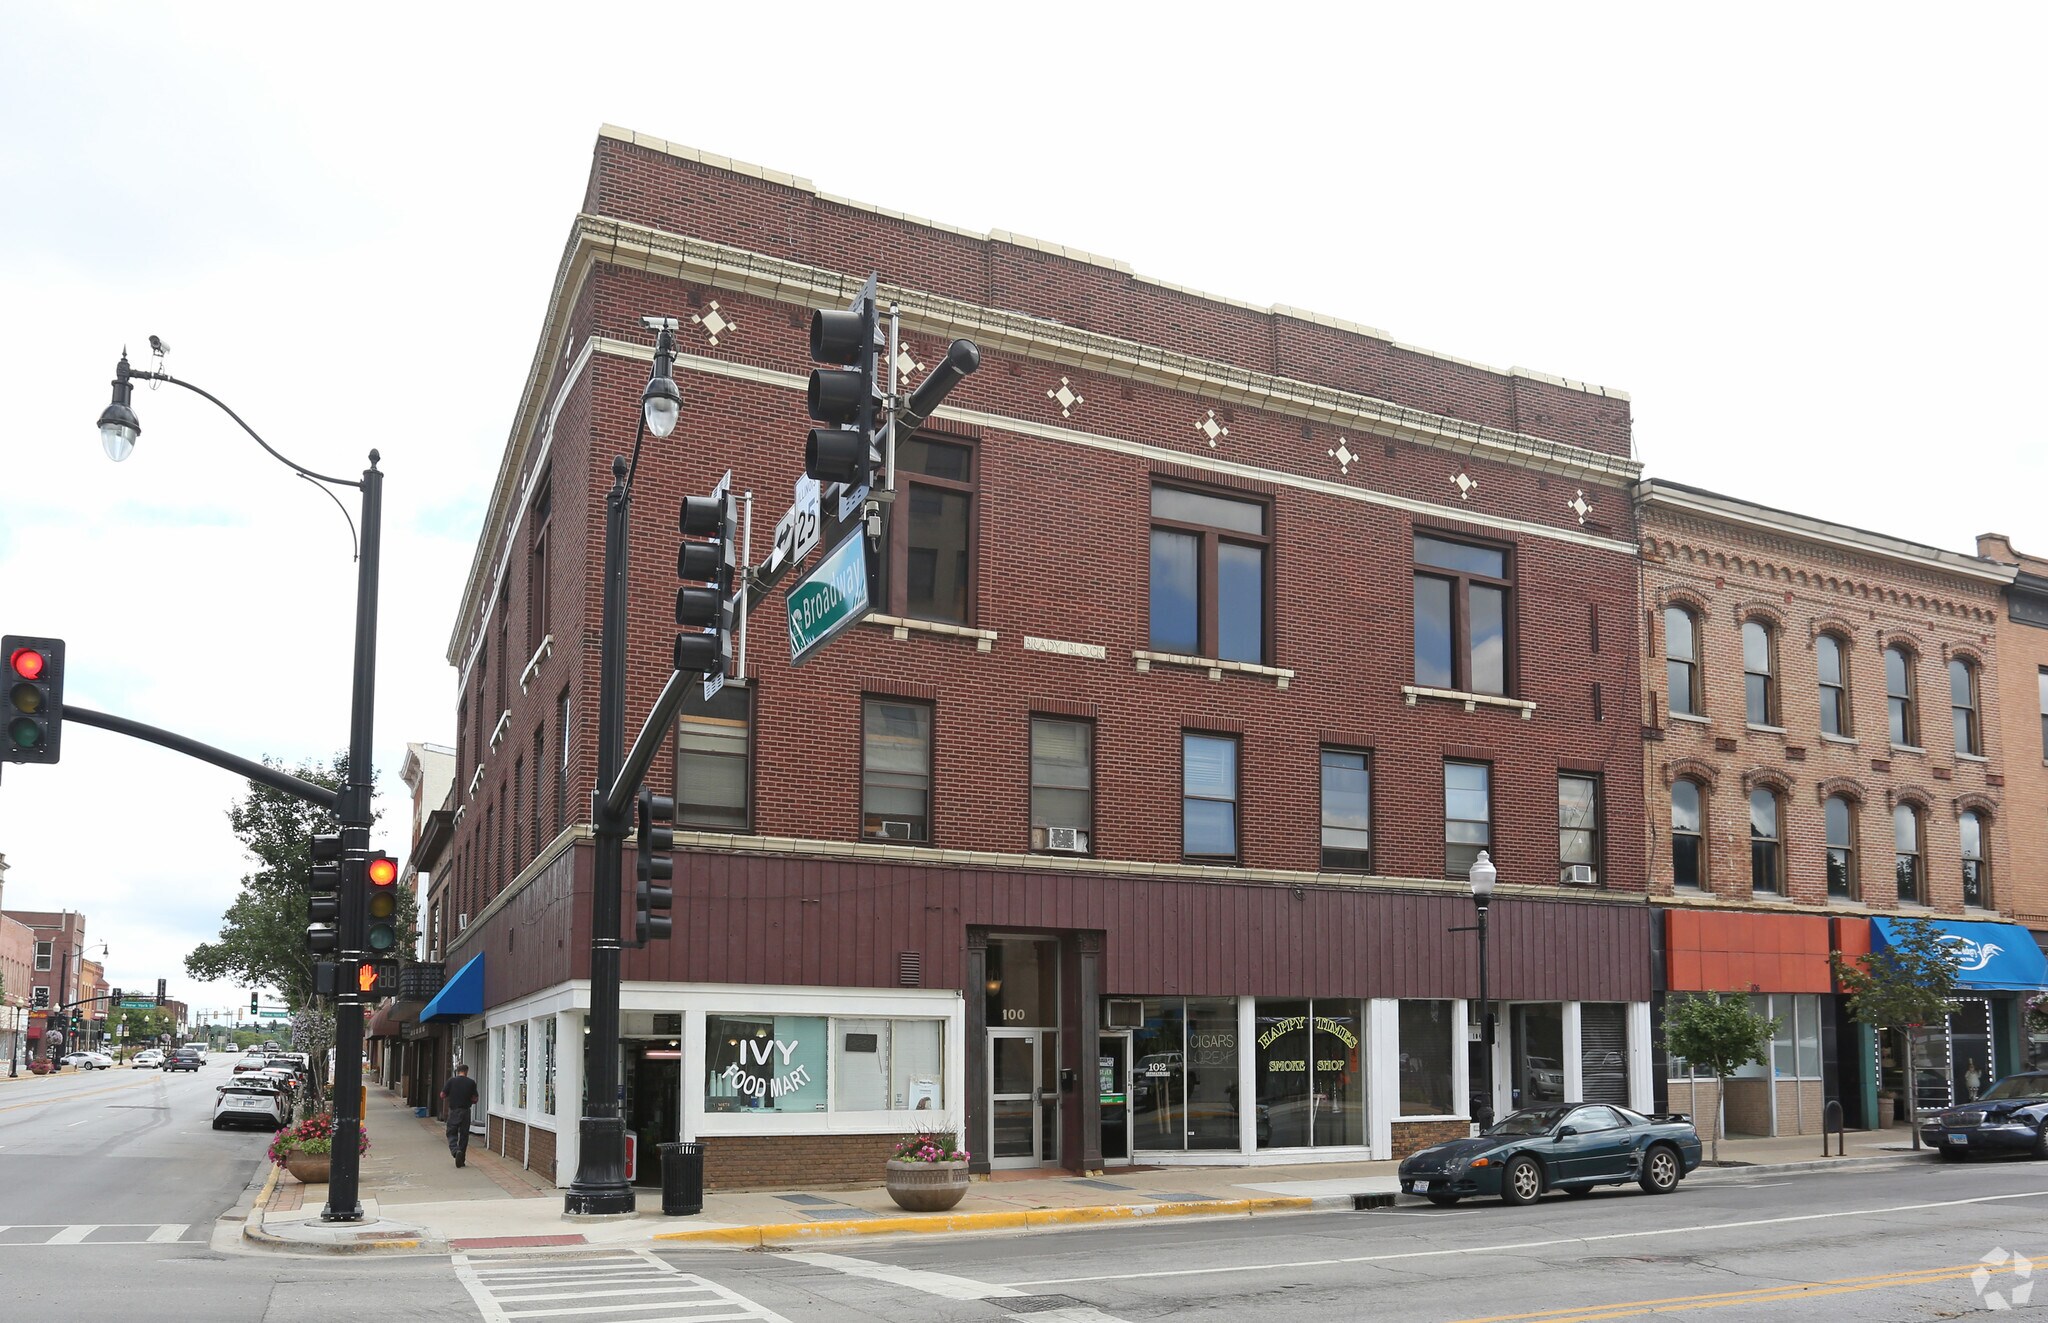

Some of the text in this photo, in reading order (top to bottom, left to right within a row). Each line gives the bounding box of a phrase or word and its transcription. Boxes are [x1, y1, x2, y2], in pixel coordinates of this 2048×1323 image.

[797, 497, 816, 550] 25
[802, 558, 861, 630] Broadway
[1024, 637, 1104, 659] BRADY BLOCK
[1002, 1009, 1025, 1020] 100
[1190, 1034, 1234, 1048] CIGARS
[1257, 1016, 1359, 1050] HAPPY TIMES
[739, 1039, 799, 1065] IVY
[1194, 1050, 1229, 1064] OPEN
[1148, 1063, 1167, 1072] 102
[1268, 1060, 1306, 1072] SMOKE
[1316, 1060, 1345, 1071] SHOP
[721, 1063, 811, 1098] FOOD MART
